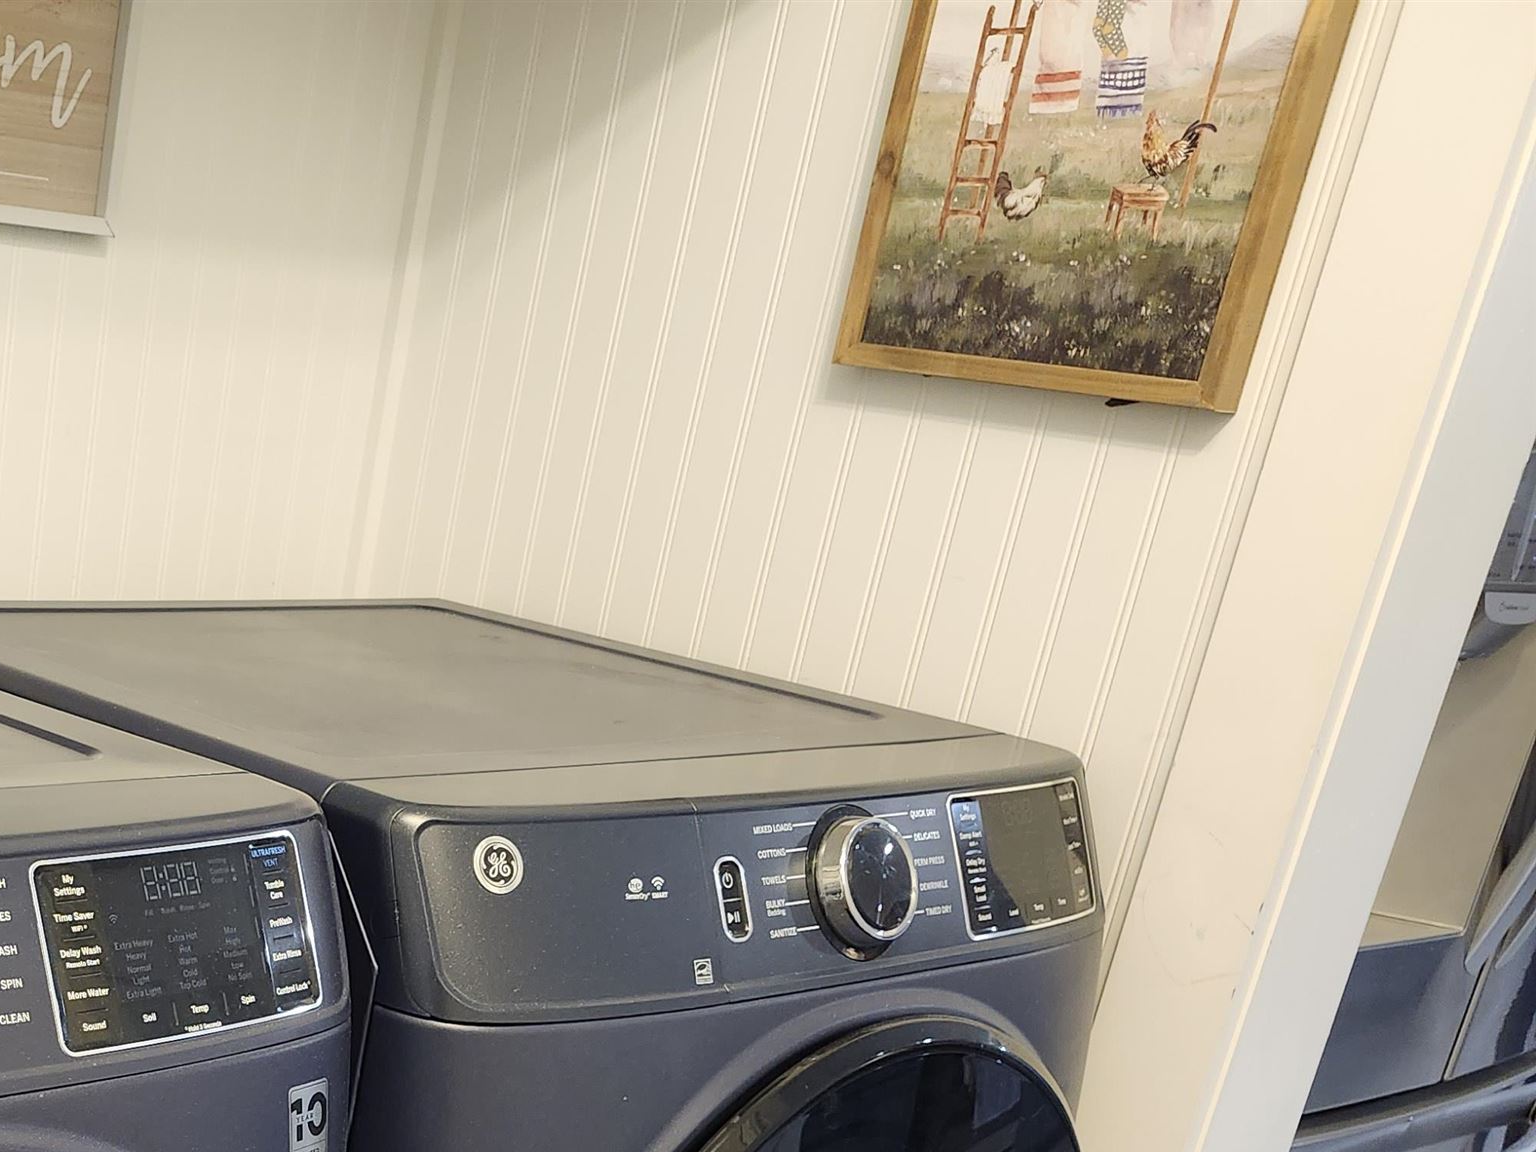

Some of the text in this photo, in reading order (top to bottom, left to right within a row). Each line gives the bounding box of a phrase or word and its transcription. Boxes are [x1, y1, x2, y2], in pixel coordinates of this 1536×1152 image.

[910, 808, 937, 820] QUICK DRY
[752, 822, 793, 835] MIXED LOADS
[913, 830, 941, 841] DELICATES
[757, 847, 786, 859] COTTONS
[61, 874, 74, 885] My
[761, 874, 787, 886] TOWELS
[53, 886, 85, 897] Settings
[765, 899, 785, 909] BULKY
[53, 911, 95, 923] Time Saver
[769, 926, 798, 939] SANITIZE
[59, 945, 102, 958] Delay Wash
[0, 978, 24, 990] SPIN
[66, 987, 110, 1001] More Water
[240, 994, 256, 1005] Spin
[190, 1004, 210, 1014] Temp
[142, 1012, 157, 1023] Soil
[82, 1019, 107, 1032] Sound
[291, 1091, 327, 1142] 10
[296, 1112, 314, 1123] YEAR
